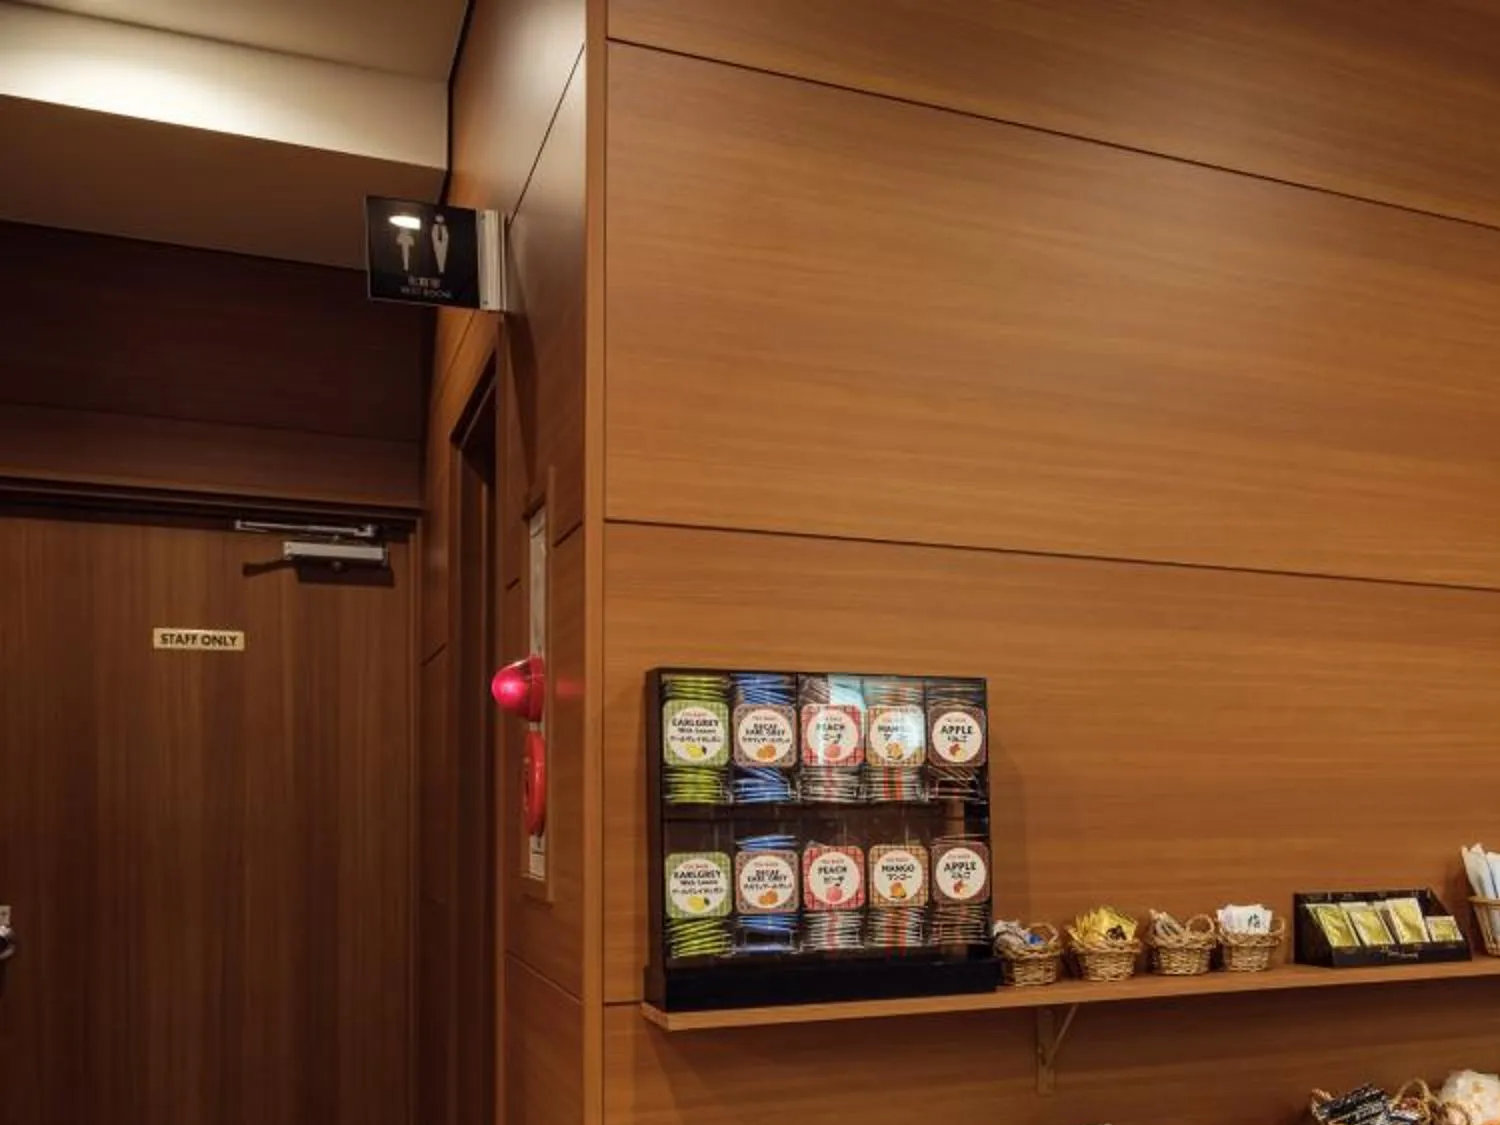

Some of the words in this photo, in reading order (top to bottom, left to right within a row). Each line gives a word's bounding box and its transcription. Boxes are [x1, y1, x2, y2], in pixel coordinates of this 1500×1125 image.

[161, 633, 198, 645] STAFF
[201, 634, 238, 647] ONLY
[941, 725, 974, 735] APPLE
[817, 866, 848, 875] PEACH
[881, 864, 916, 873] MANGO
[943, 861, 977, 872] APPLE
